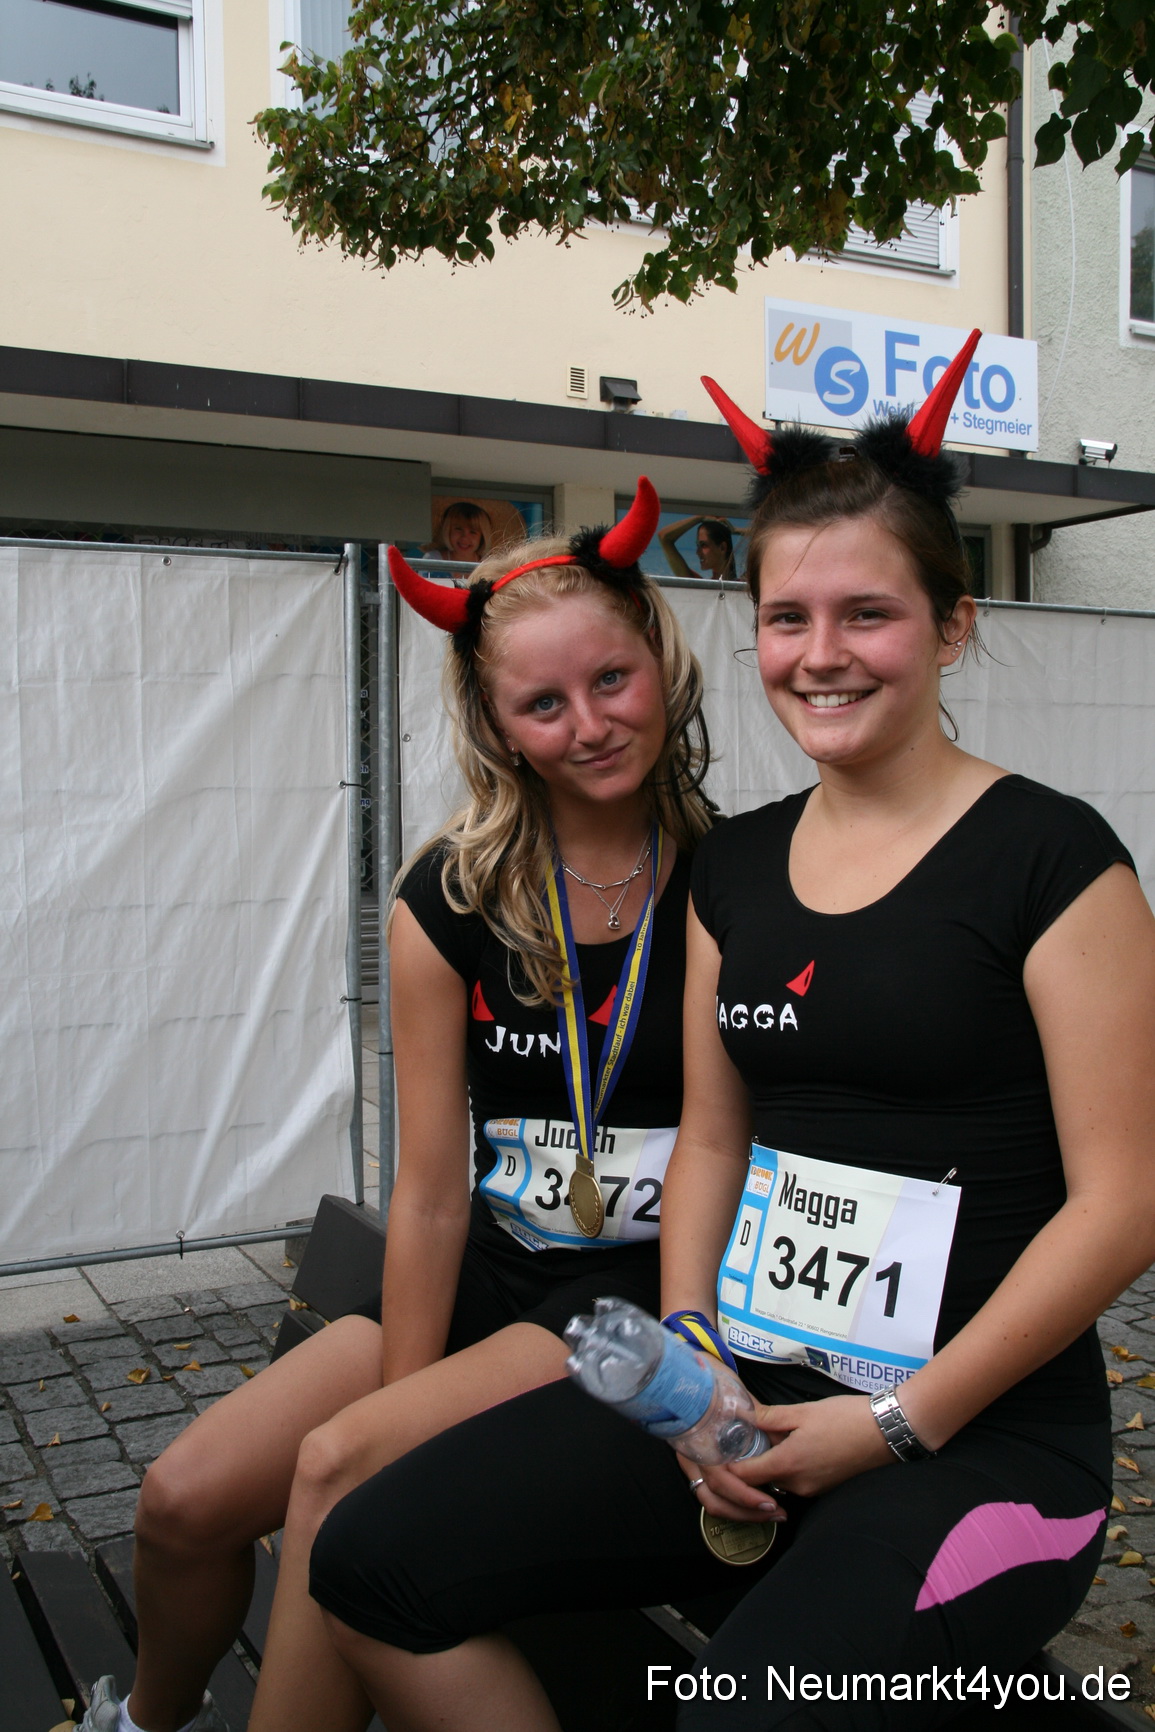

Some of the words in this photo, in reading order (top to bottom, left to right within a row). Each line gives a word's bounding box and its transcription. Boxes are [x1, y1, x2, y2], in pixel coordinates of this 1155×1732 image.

[884, 329, 1016, 413] Foto
[950, 412, 959, 424] +
[963, 411, 1032, 436] Stegmeier
[626, 981, 635, 1002] dabei
[618, 1017, 627, 1030] ich
[622, 1003, 630, 1017] war
[716, 995, 799, 1031] AGGA
[607, 1034, 623, 1066] Stadtlauf
[534, 1118, 616, 1154] Judh
[505, 1155, 516, 1177] D
[535, 1167, 663, 1224] 372
[778, 1171, 858, 1229] Magga
[740, 1220, 751, 1246] D
[768, 1236, 902, 1318] 3471
[728, 1327, 774, 1353] BOCK
